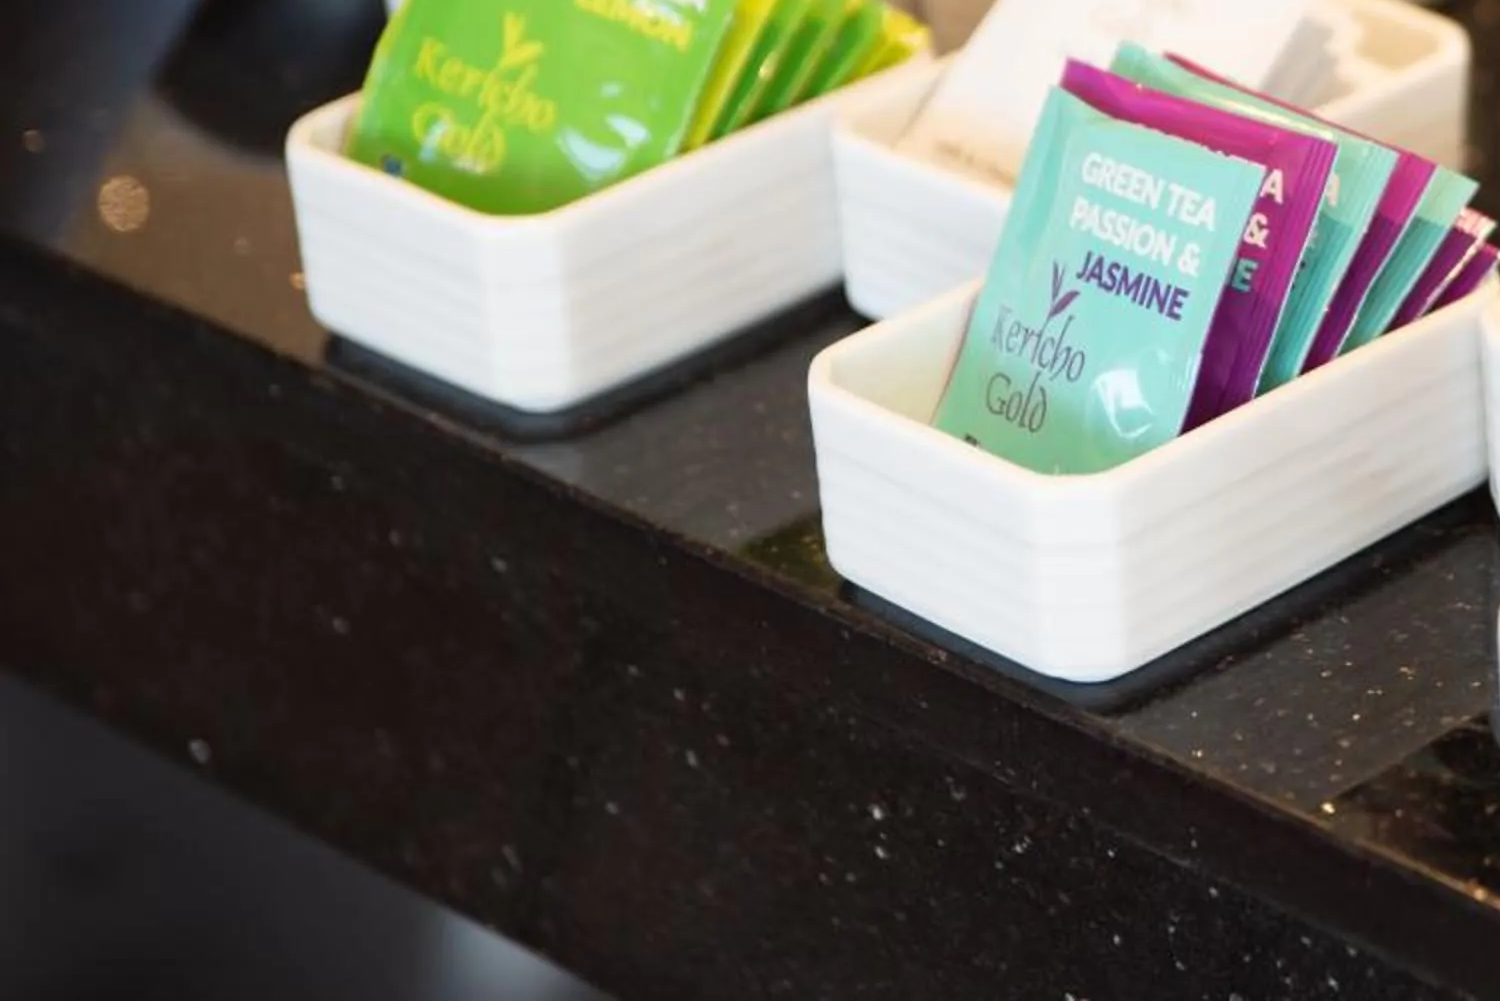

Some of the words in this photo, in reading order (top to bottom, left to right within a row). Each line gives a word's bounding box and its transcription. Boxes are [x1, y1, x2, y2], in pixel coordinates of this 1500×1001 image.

[1081, 151, 1167, 213] GREEN
[1166, 183, 1217, 232] TEA
[1068, 199, 1176, 263] PASSION
[1176, 242, 1202, 278] &
[1074, 249, 1191, 322] JASMINE
[990, 303, 1087, 384] Kericho
[985, 371, 1049, 434] Gold
